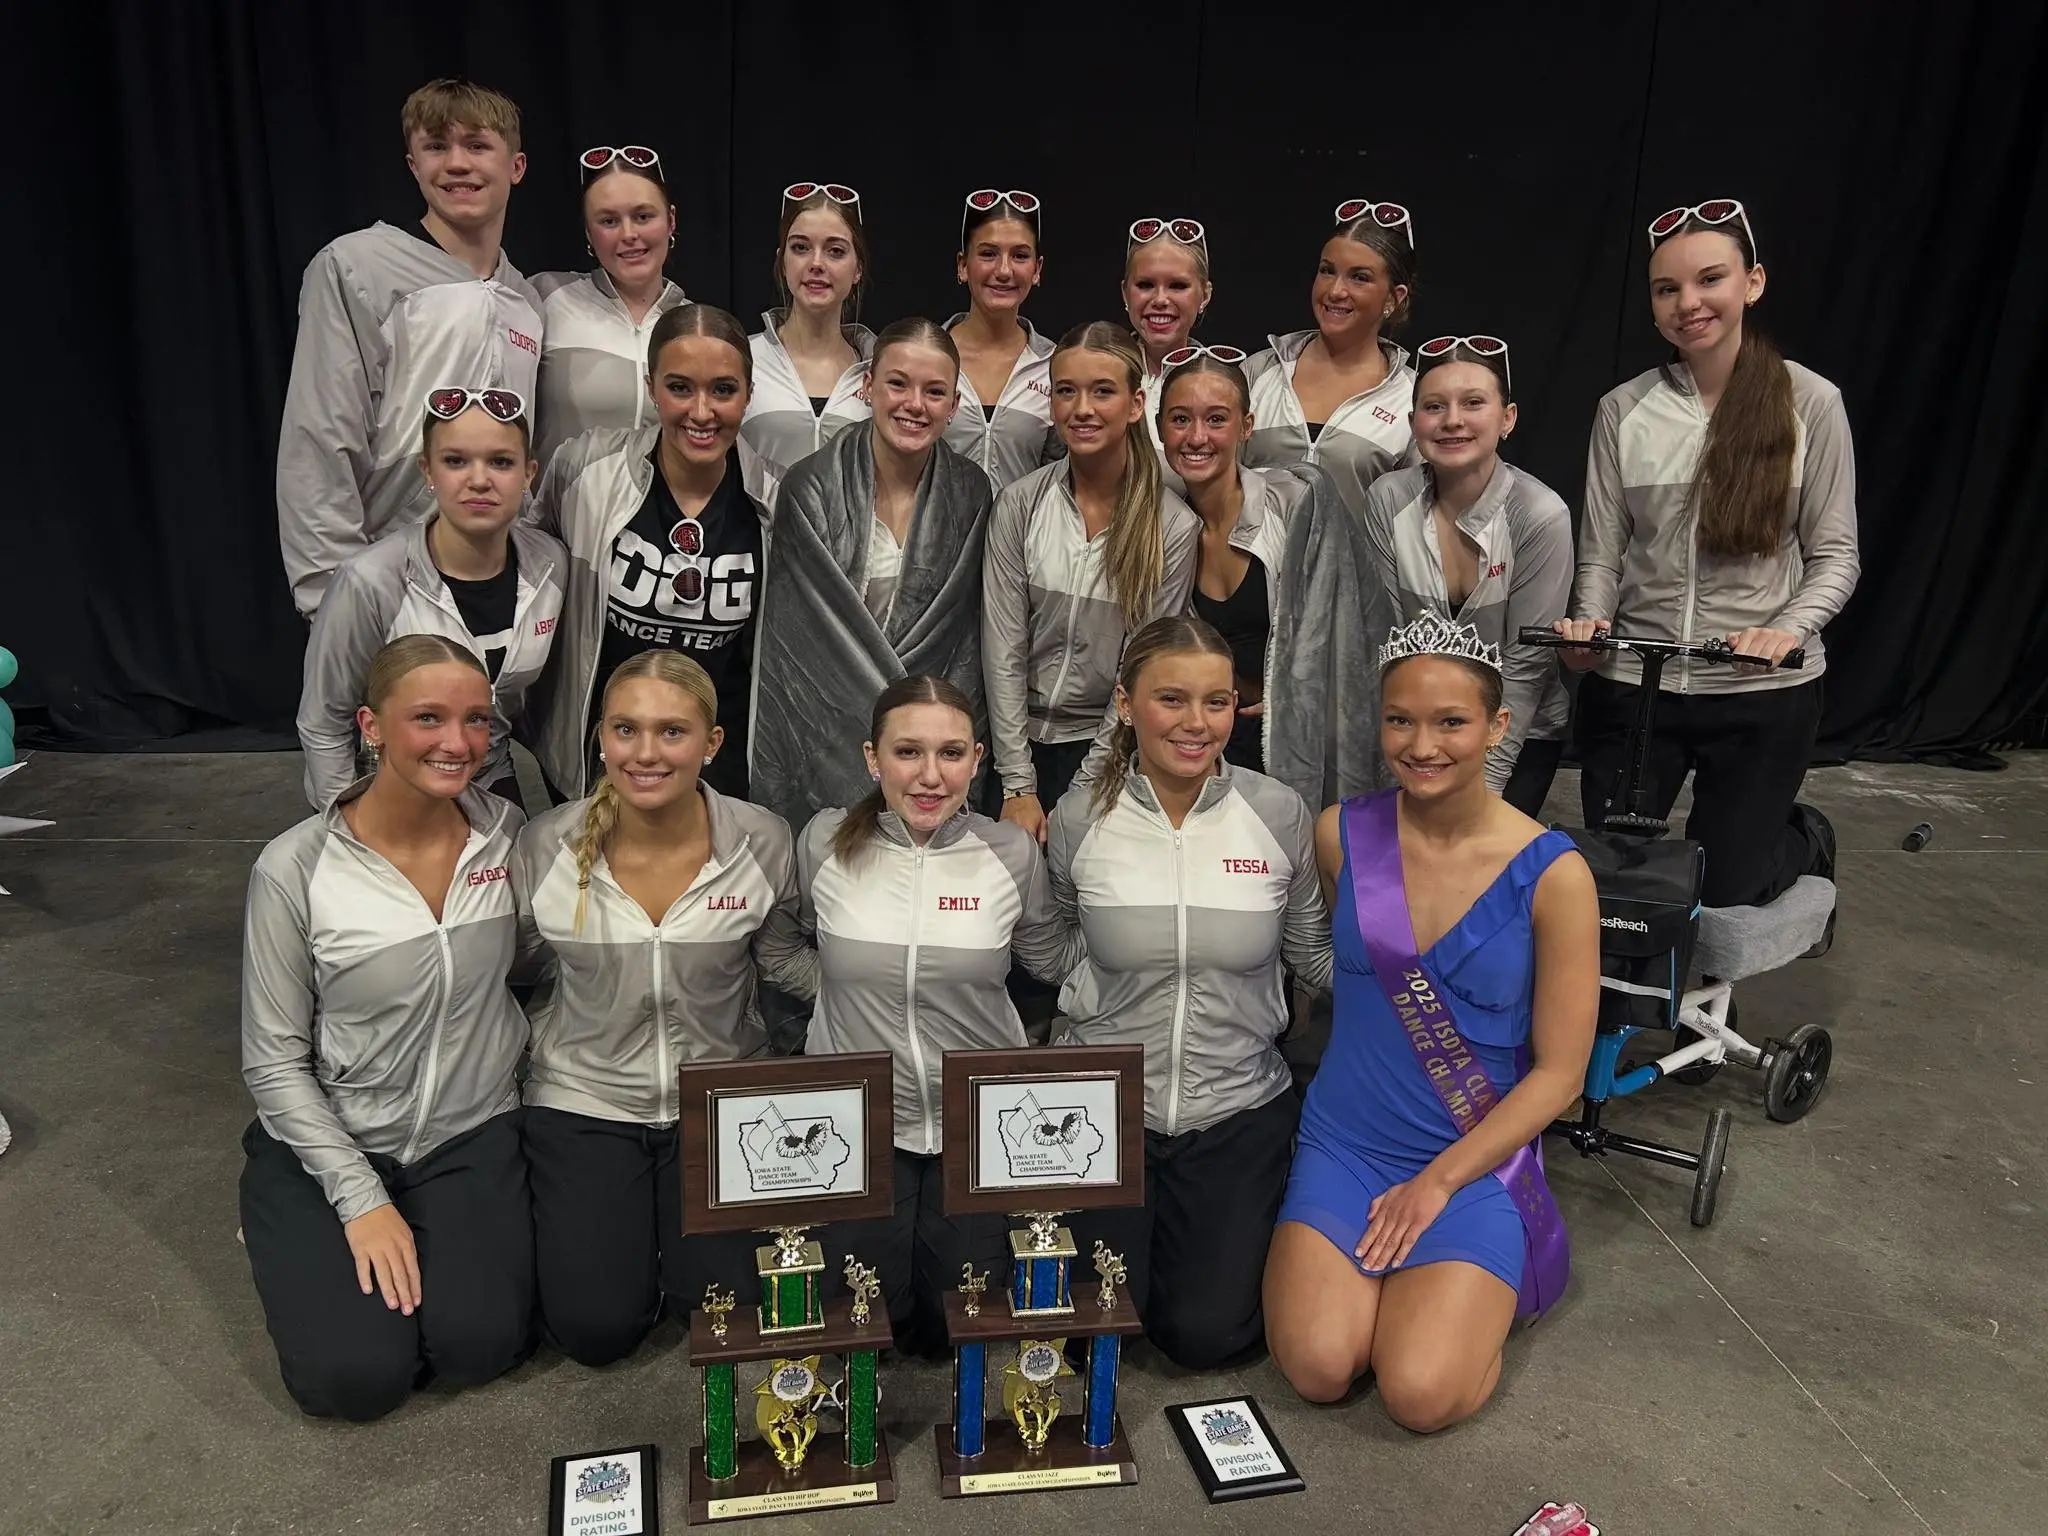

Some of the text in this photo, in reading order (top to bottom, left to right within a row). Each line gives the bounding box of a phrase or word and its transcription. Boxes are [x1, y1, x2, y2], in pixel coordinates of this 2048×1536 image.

[1371, 406, 1397, 424] IZZY
[607, 611, 673, 644] ANCE
[1222, 859, 1269, 874] TESSA
[707, 896, 747, 910] LAILA
[938, 896, 980, 911] EMILY
[1600, 917, 1648, 933] ssReach
[1392, 992, 1435, 1052] DANCE
[1402, 968, 1443, 1015] 2025
[1432, 1020, 1473, 1071] ISDTA
[762, 1177, 812, 1186] CHAMPIONSHIPS
[1206, 1428, 1227, 1440] STATE
[1226, 1421, 1250, 1433] DANCE
[1216, 1451, 1272, 1466] DIVISION 1
[1229, 1463, 1271, 1477] RATING
[577, 1484, 601, 1496] STATE
[602, 1474, 630, 1489] DANCE
[571, 1508, 635, 1526] DIVISION 1
[580, 1522, 628, 1536] RATING
